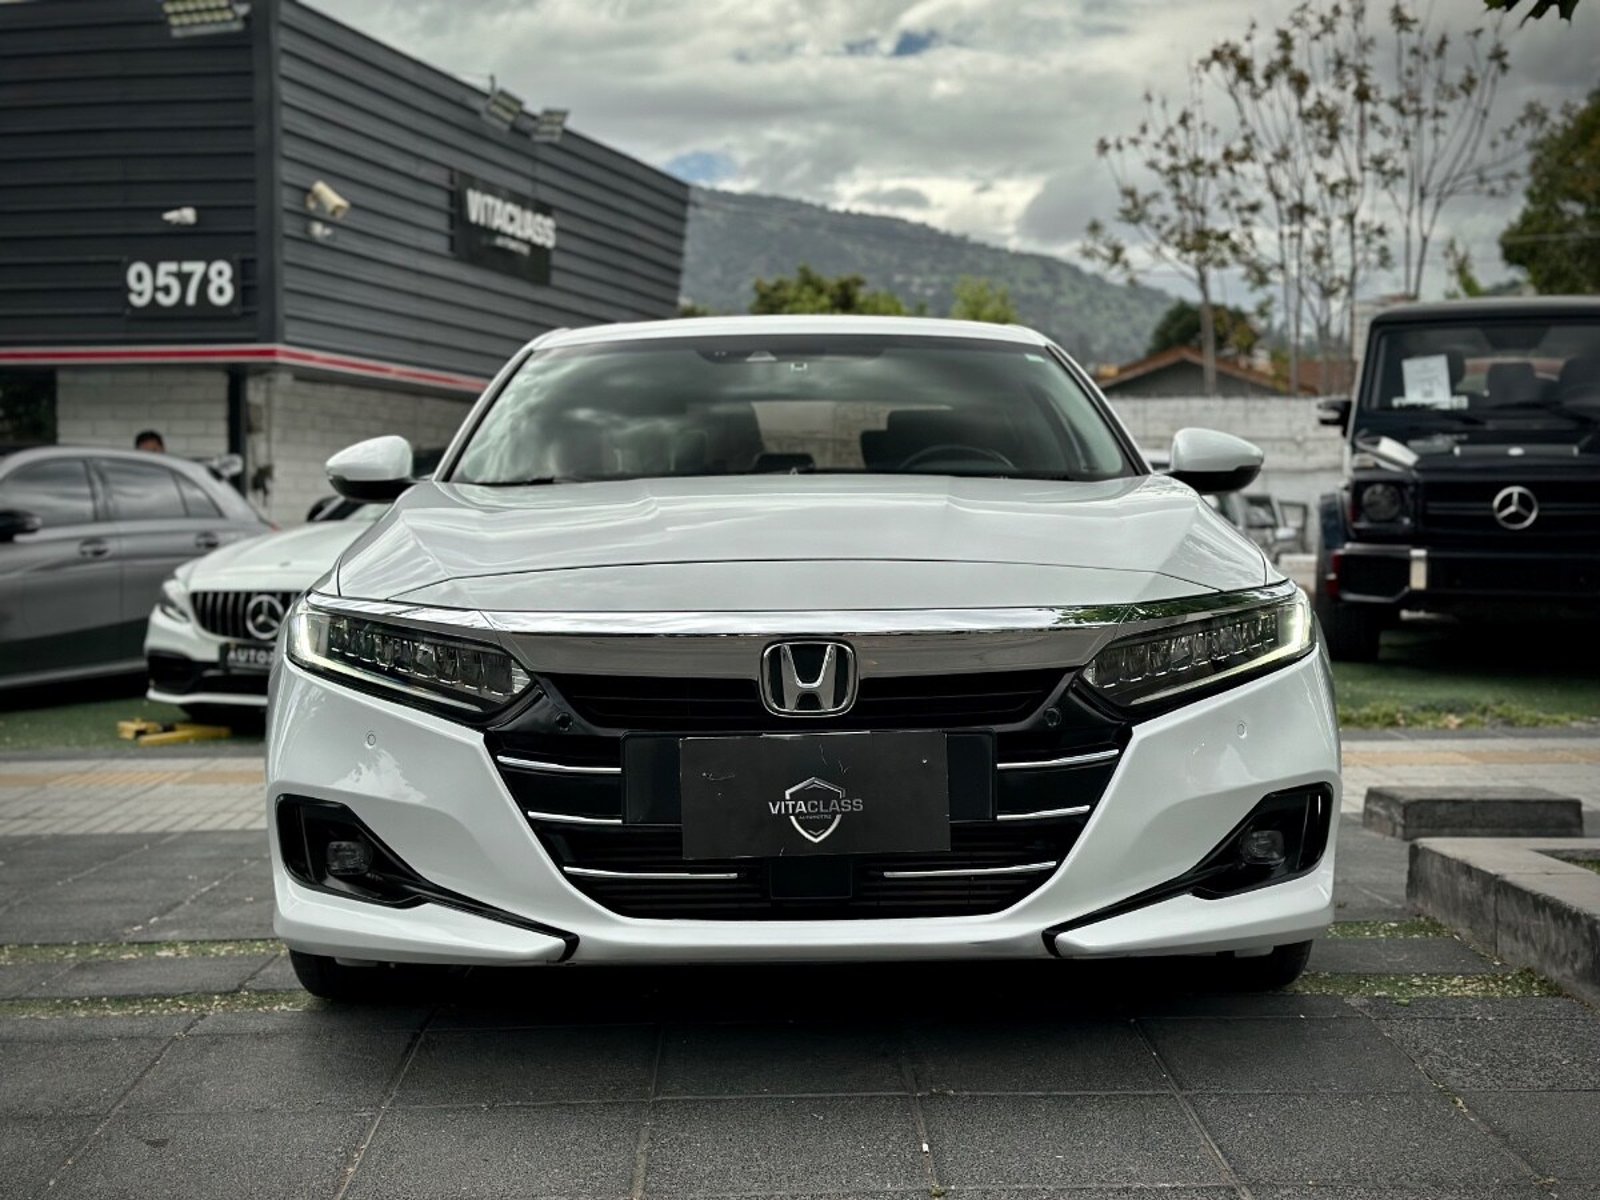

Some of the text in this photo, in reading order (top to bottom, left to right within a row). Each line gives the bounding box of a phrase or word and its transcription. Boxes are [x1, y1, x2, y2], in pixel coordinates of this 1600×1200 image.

[466, 188, 556, 249] VITACLASS
[126, 260, 235, 307] 9578
[768, 798, 864, 815] VITACLASS
